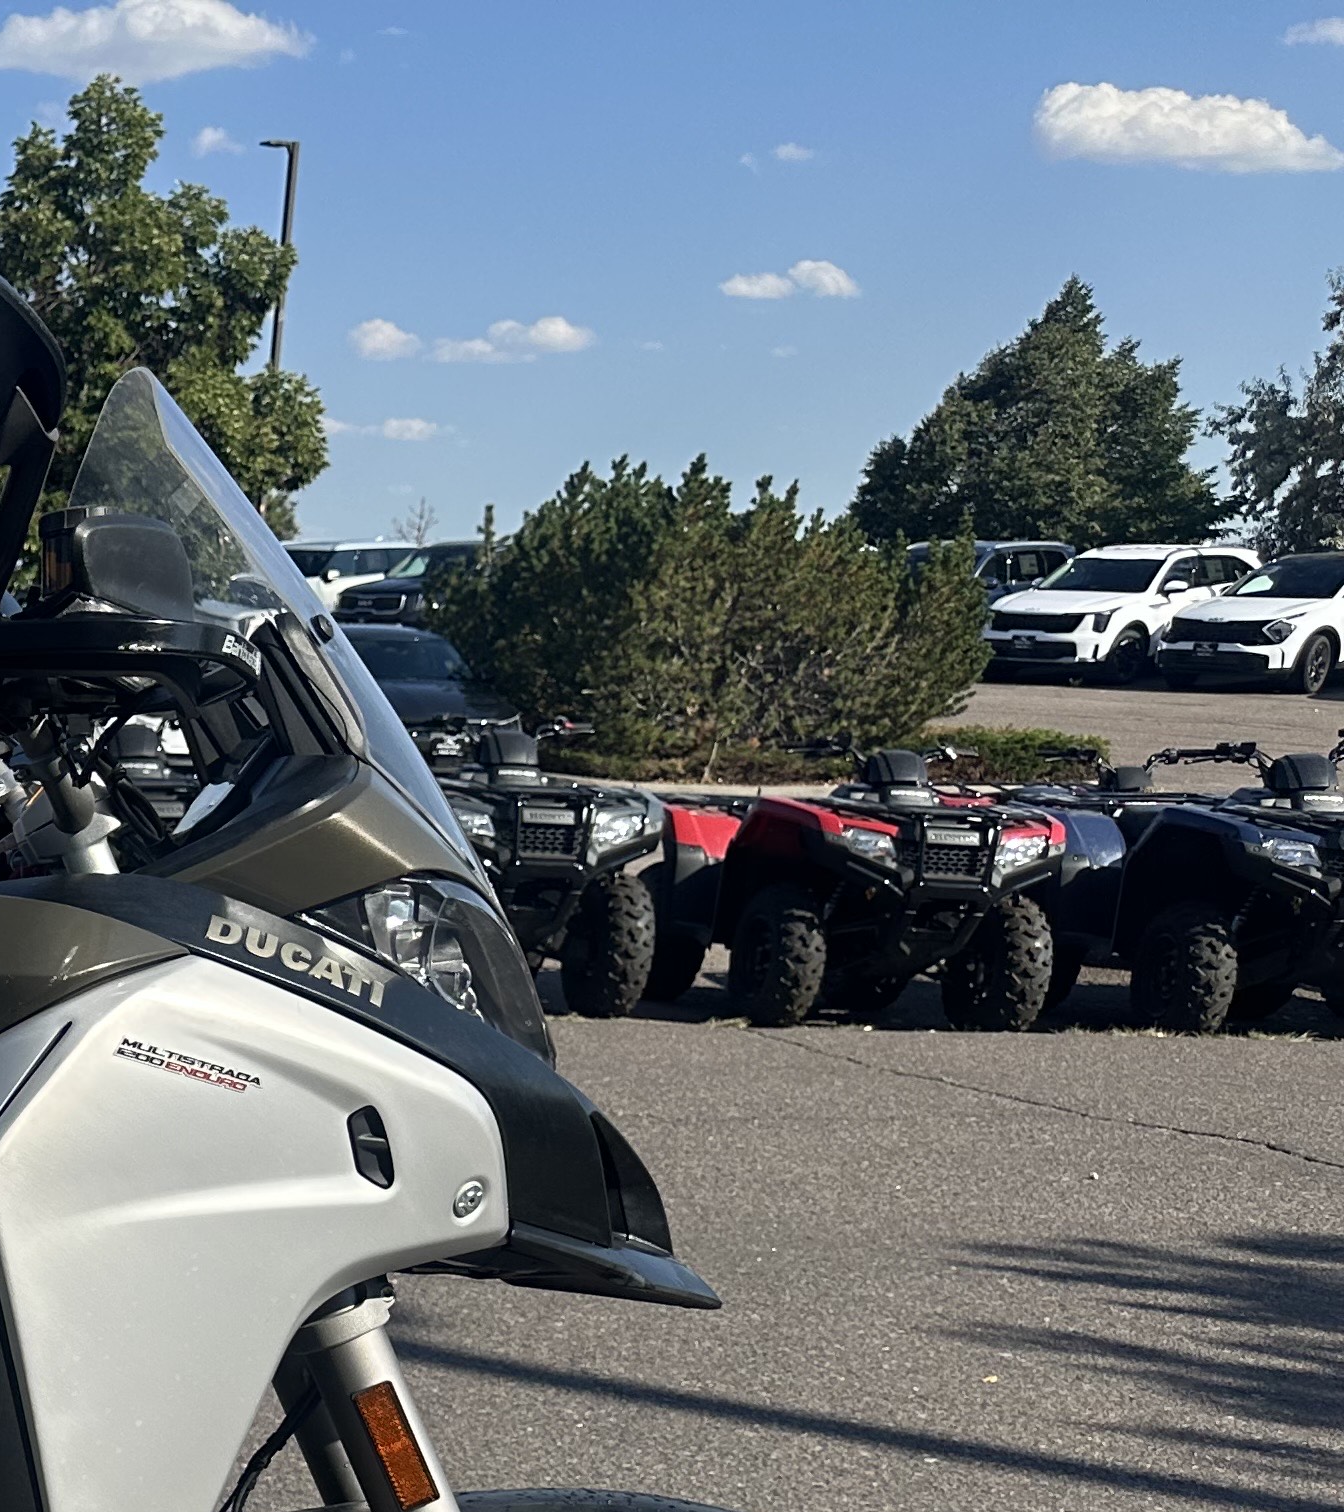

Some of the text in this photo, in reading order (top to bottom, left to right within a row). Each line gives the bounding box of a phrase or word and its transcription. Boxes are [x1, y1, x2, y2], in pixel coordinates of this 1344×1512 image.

[204, 914, 386, 1009] DUCATI
[120, 1037, 262, 1087] MULTISTRADA
[164, 1060, 248, 1092] ENDURO
